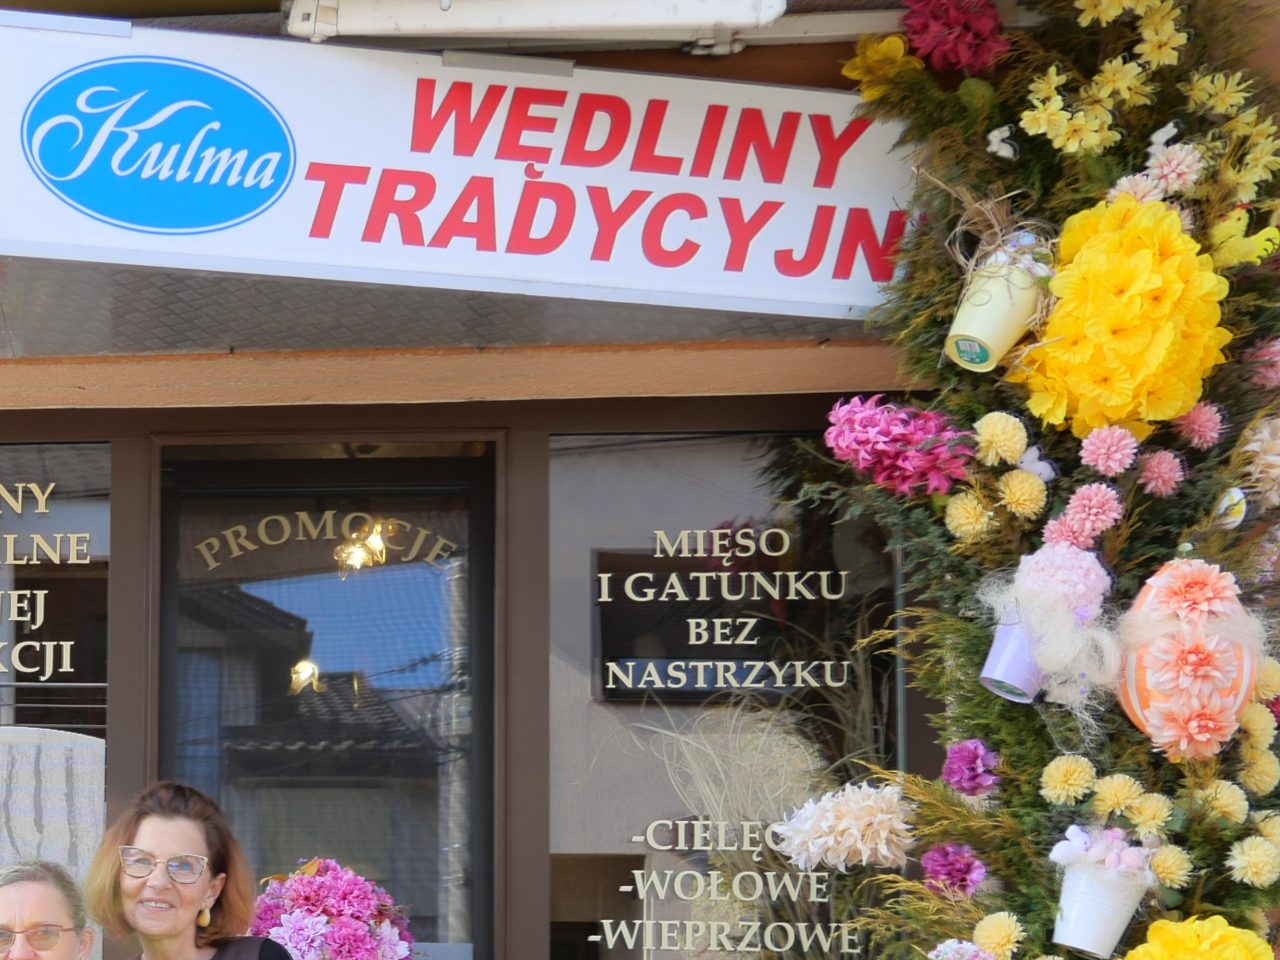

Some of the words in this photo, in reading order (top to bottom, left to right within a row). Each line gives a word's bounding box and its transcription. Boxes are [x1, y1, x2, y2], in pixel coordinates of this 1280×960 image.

[31, 85, 283, 190] Kulma
[409, 77, 875, 189] WĘDLINY
[305, 162, 910, 283] TRADYCYJN
[194, 510, 459, 572] PROMOCJE
[653, 528, 790, 567] MIĘSO
[597, 573, 613, 602] I
[623, 571, 849, 602] GATUNKU
[686, 618, 760, 645] BEZ
[605, 661, 852, 689] NASTRZYKU
[618, 869, 832, 902] -WOŁOWE
[587, 919, 864, 953] -WIEPRZOWE
